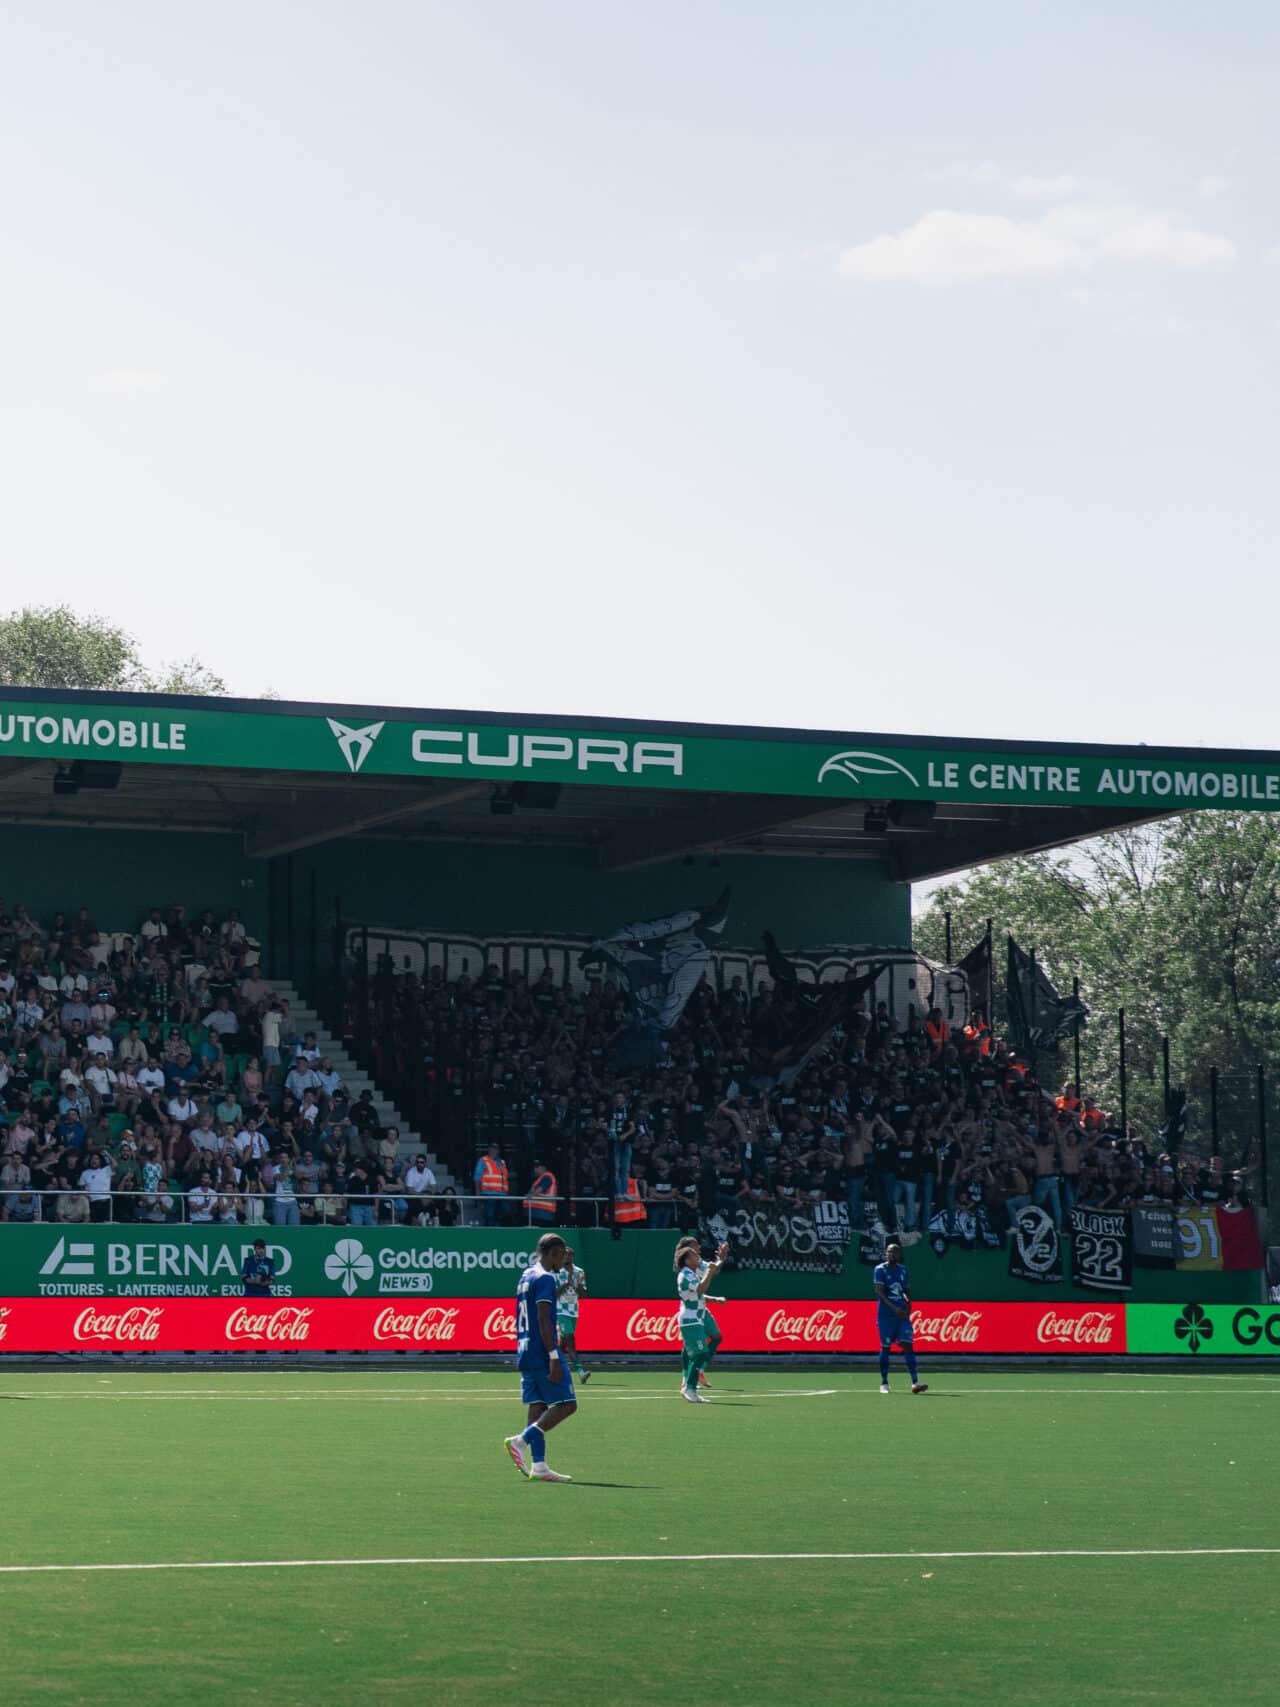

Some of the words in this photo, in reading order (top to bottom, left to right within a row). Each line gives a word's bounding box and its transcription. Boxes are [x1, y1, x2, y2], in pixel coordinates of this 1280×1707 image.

[412, 729, 683, 776] CUPRA
[927, 762, 959, 788] LE
[969, 763, 1081, 792] CENTRE
[1097, 768, 1280, 800] AUTOMOBILE
[1070, 1209, 1127, 1237] BLOCK
[1075, 1234, 1124, 1281] 22
[38, 1283, 105, 1296] TOITURES
[116, 1284, 209, 1297] LANTERNEAUX
[221, 1284, 293, 1298] EXURES
[381, 1276, 420, 1289] NEWS
[73, 1307, 164, 1341] Coca-Cola
[225, 1307, 314, 1341] Coca-Cola
[373, 1307, 460, 1341] Coca-Cola
[766, 1309, 847, 1342] Coca-Cola
[1037, 1311, 1115, 1343] Coca-Cola
